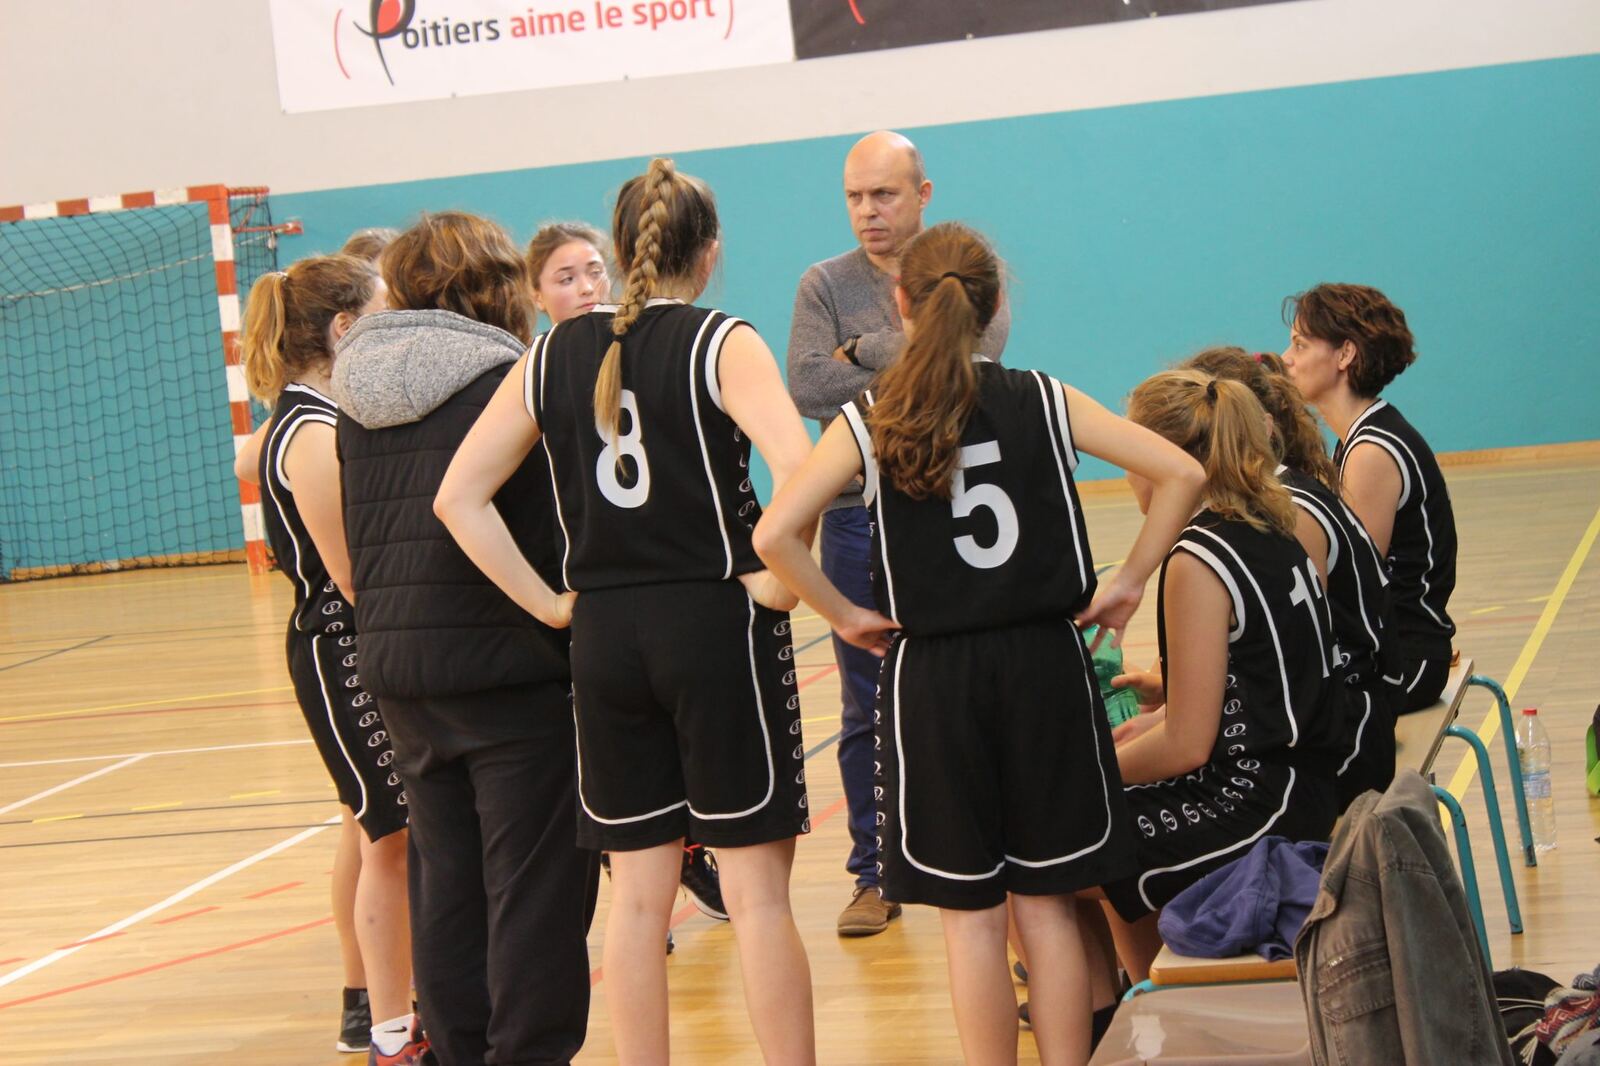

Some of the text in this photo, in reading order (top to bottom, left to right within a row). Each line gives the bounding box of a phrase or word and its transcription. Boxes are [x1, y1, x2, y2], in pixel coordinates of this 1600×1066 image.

[510, 8, 586, 38] aime
[595, 1, 623, 29] le
[631, 0, 716, 30] sport
[595, 389, 650, 508] 8
[950, 440, 1019, 569] 5
